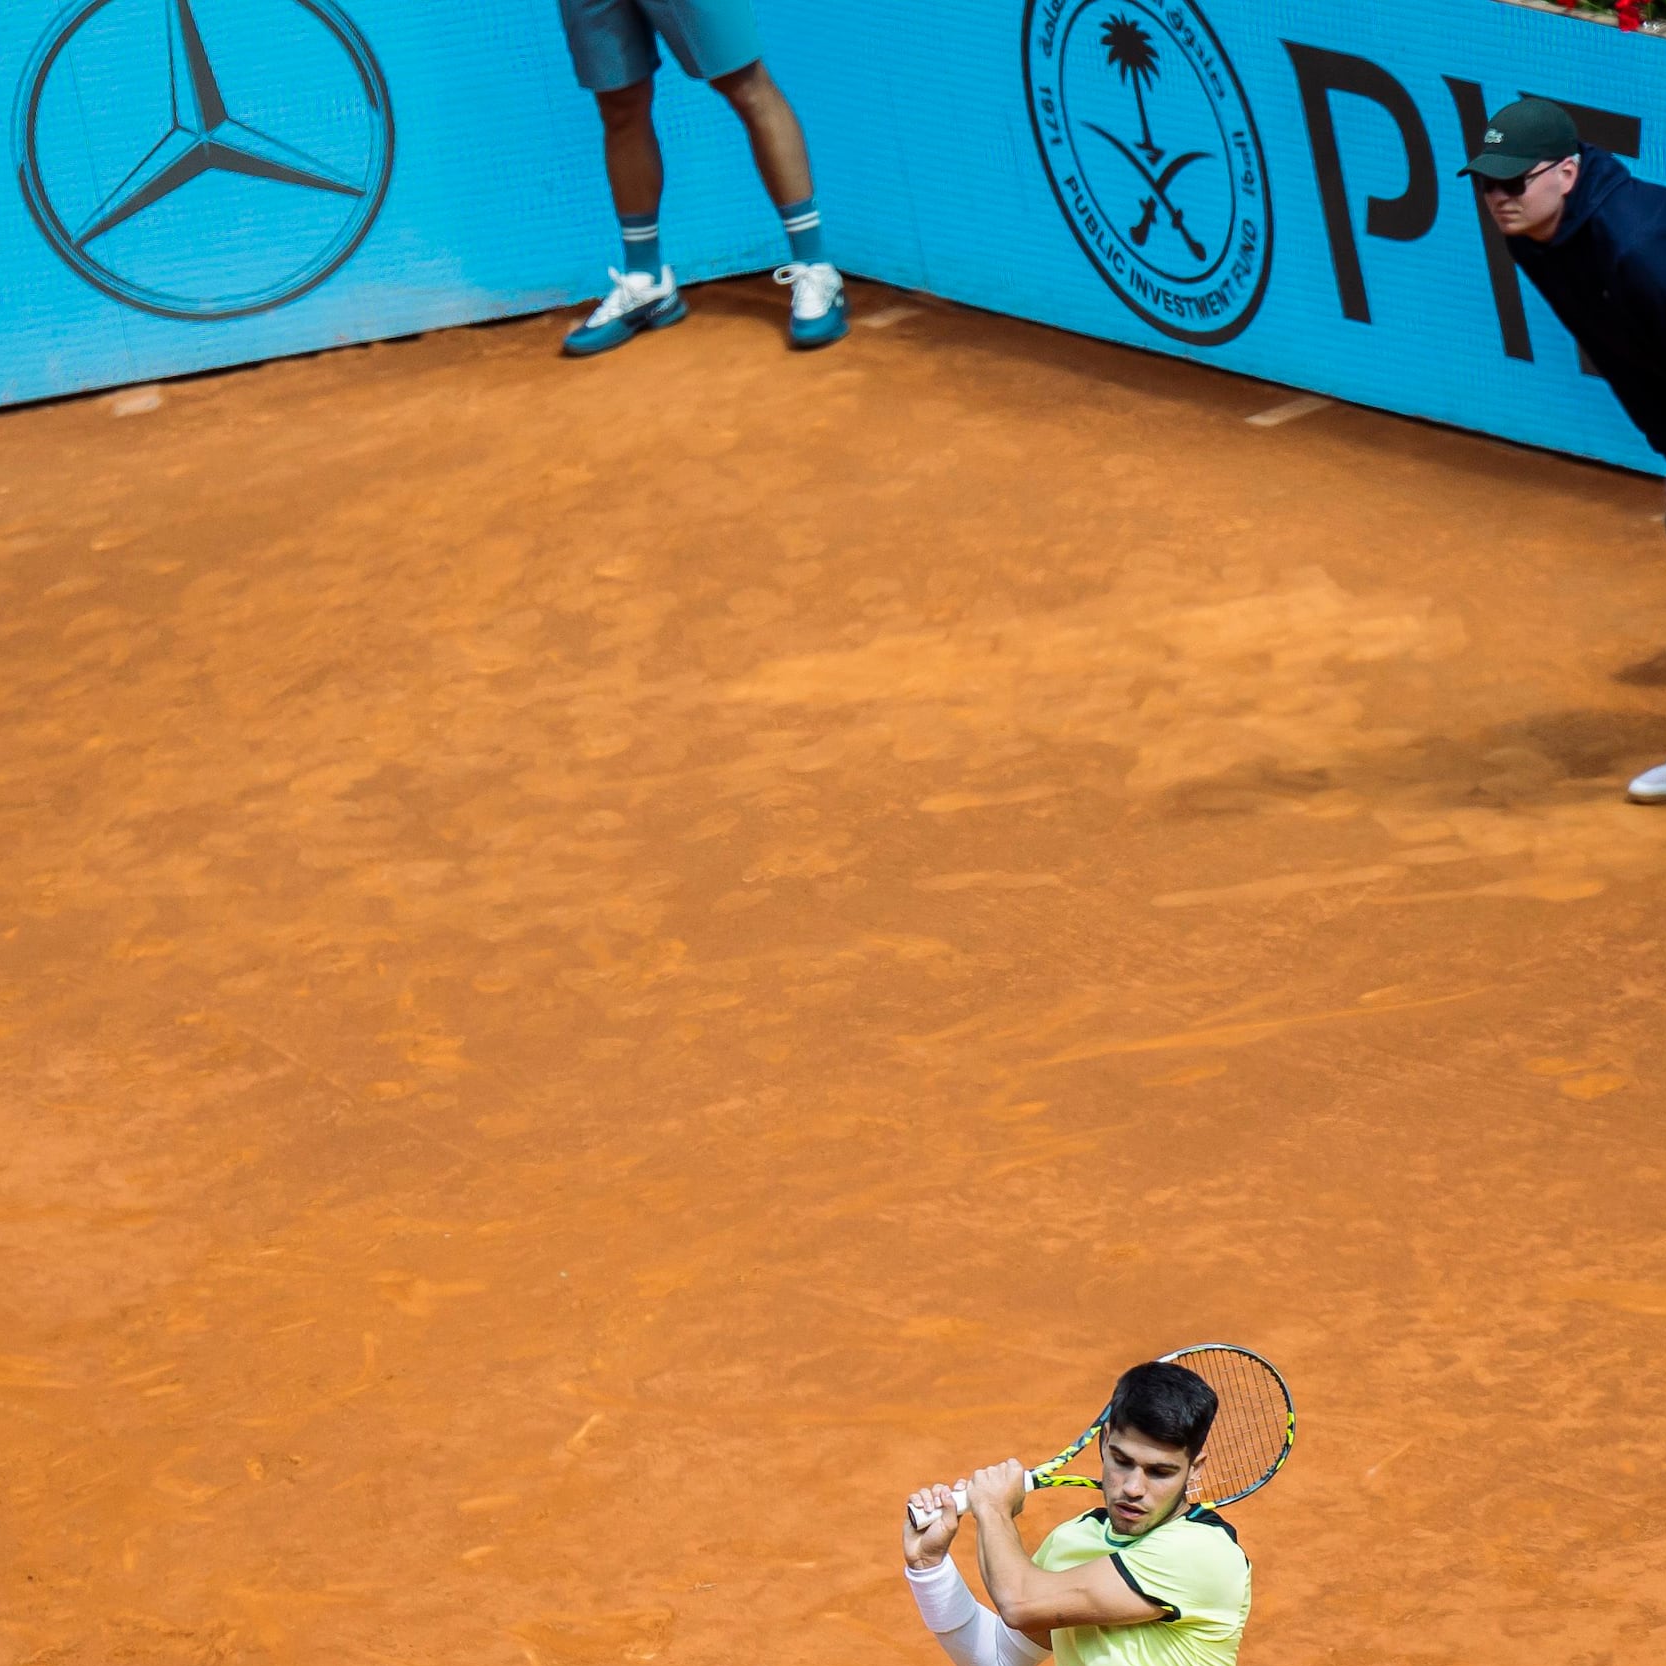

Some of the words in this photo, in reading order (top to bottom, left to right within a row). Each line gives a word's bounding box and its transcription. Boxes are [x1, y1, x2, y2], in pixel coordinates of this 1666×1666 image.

[1039, 84, 1064, 147] 1971
[1064, 174, 1125, 276] PUBLIC
[1129, 267, 1239, 321] INVESTMENT
[1230, 217, 1257, 290] FUND
